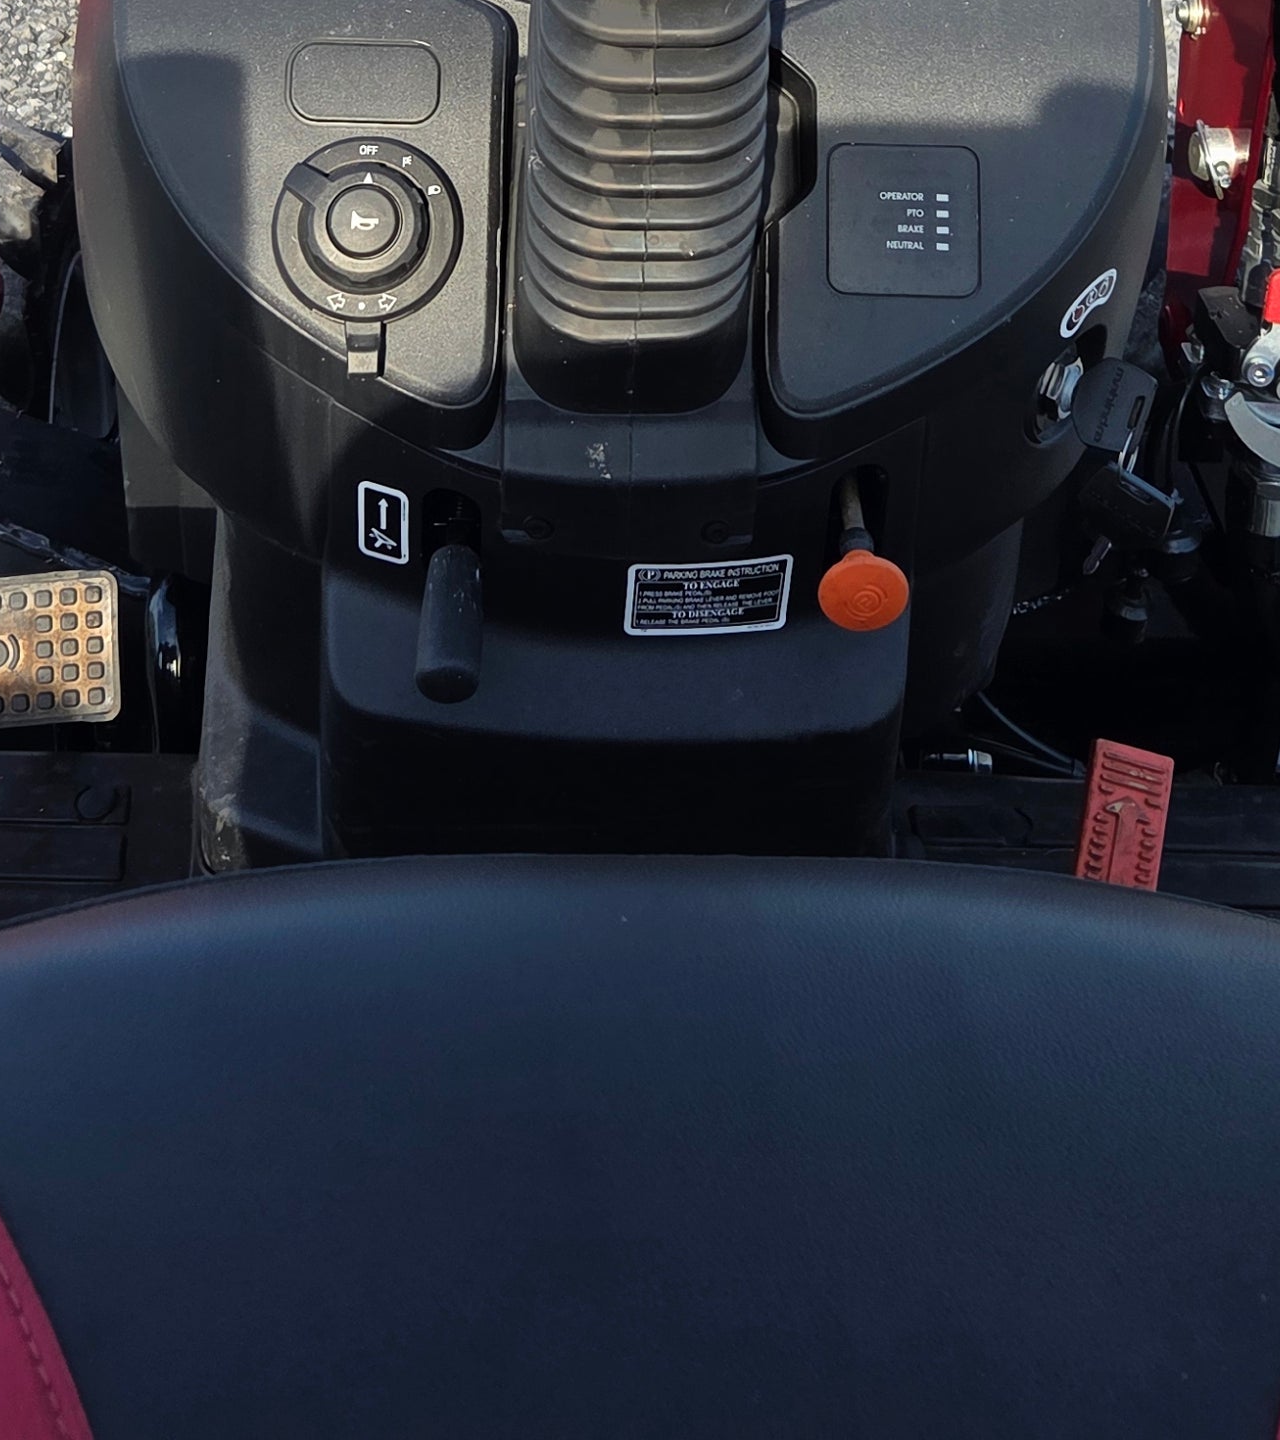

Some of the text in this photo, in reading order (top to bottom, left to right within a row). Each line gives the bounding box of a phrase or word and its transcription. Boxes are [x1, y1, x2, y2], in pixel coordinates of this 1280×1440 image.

[359, 145, 379, 156] OFF
[879, 191, 924, 202] OPERATOR
[907, 209, 924, 218] PTO
[897, 225, 924, 234] BRAKE
[886, 240, 924, 251] NEUTRAL
[663, 570, 699, 580] PARKING
[699, 568, 726, 579] BRAKE
[727, 563, 780, 577] INSTRUCTION
[682, 578, 740, 590] TO ENGAGE
[672, 607, 745, 619] TO DISENGAGE
